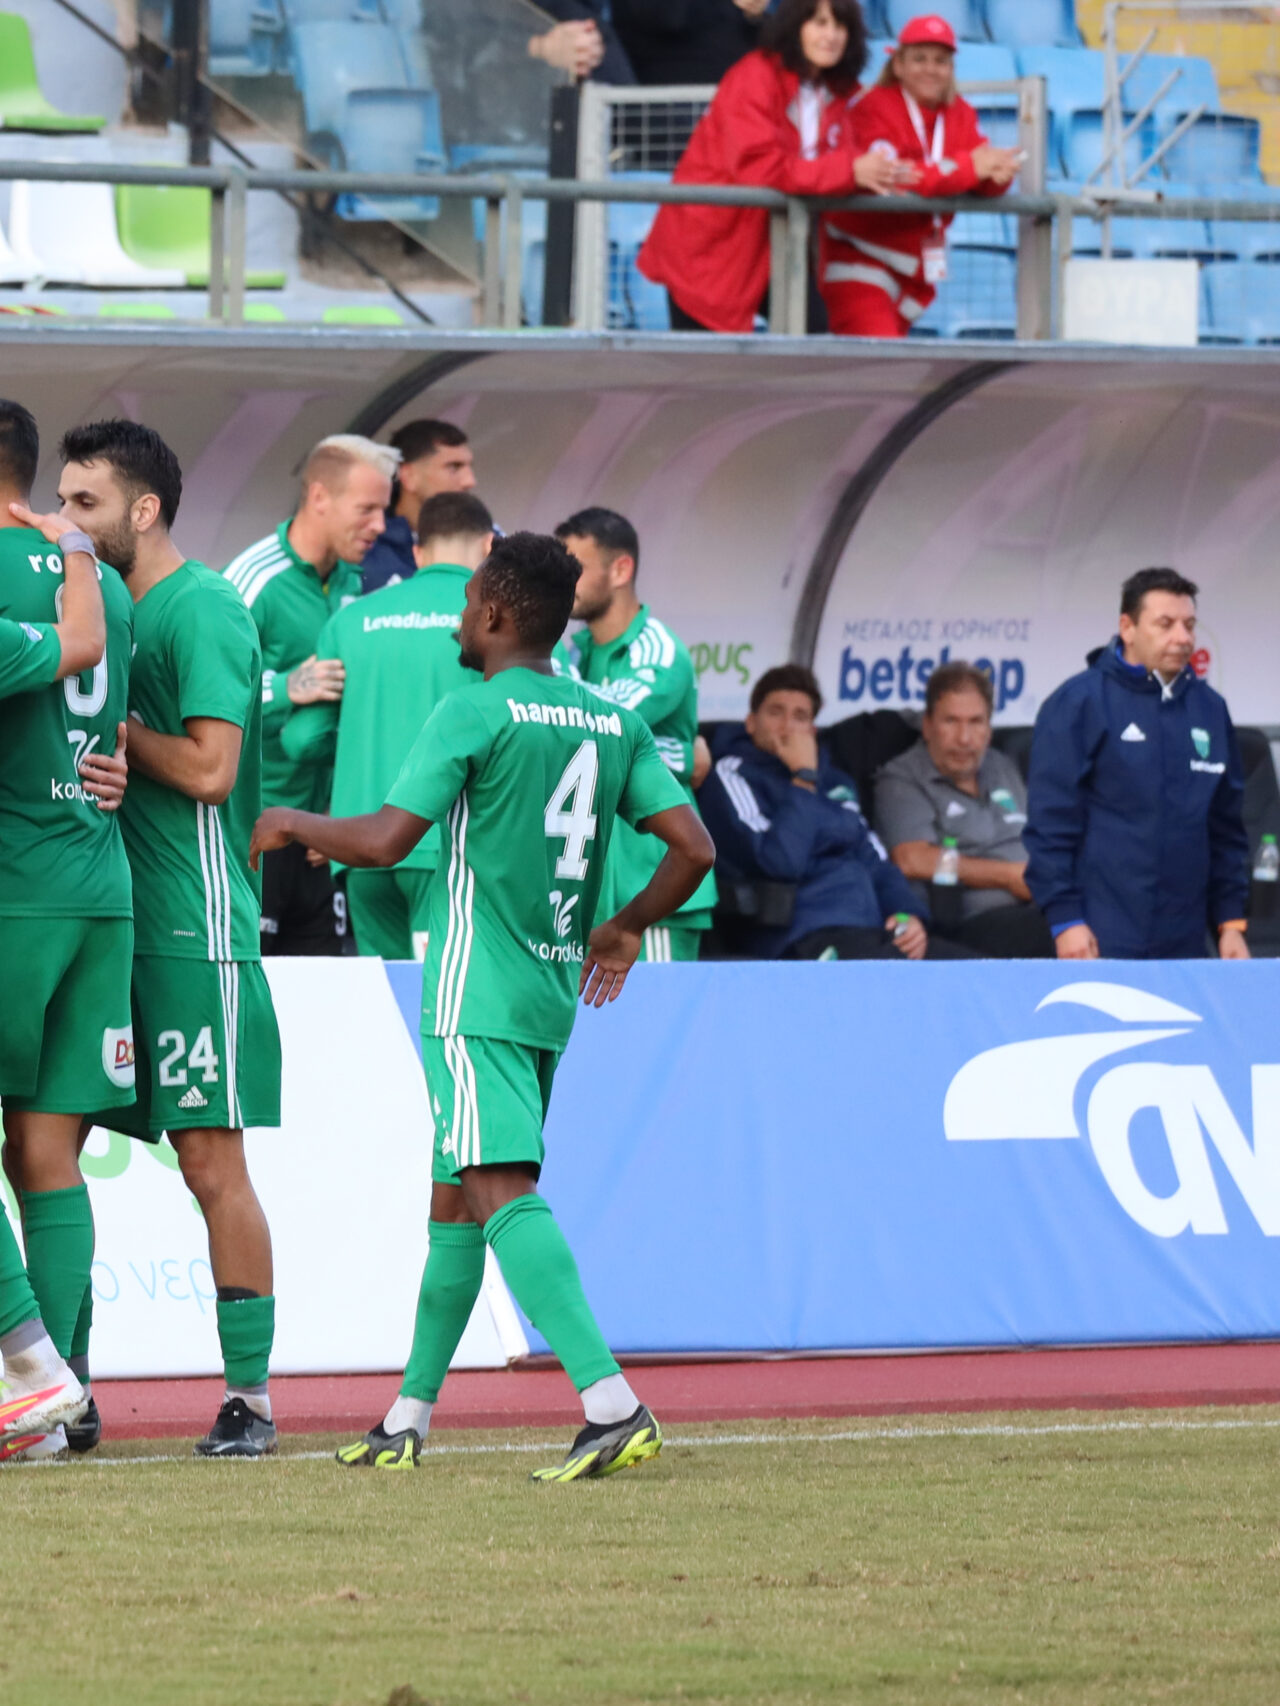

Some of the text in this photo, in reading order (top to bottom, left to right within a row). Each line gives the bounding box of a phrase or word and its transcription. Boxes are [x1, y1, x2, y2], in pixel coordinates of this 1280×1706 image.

[506, 698, 622, 737] hammond
[543, 739, 599, 881] 4
[157, 1025, 219, 1087] 24
[178, 1097, 208, 1109] adidas
[128, 1258, 219, 1315] νερ
